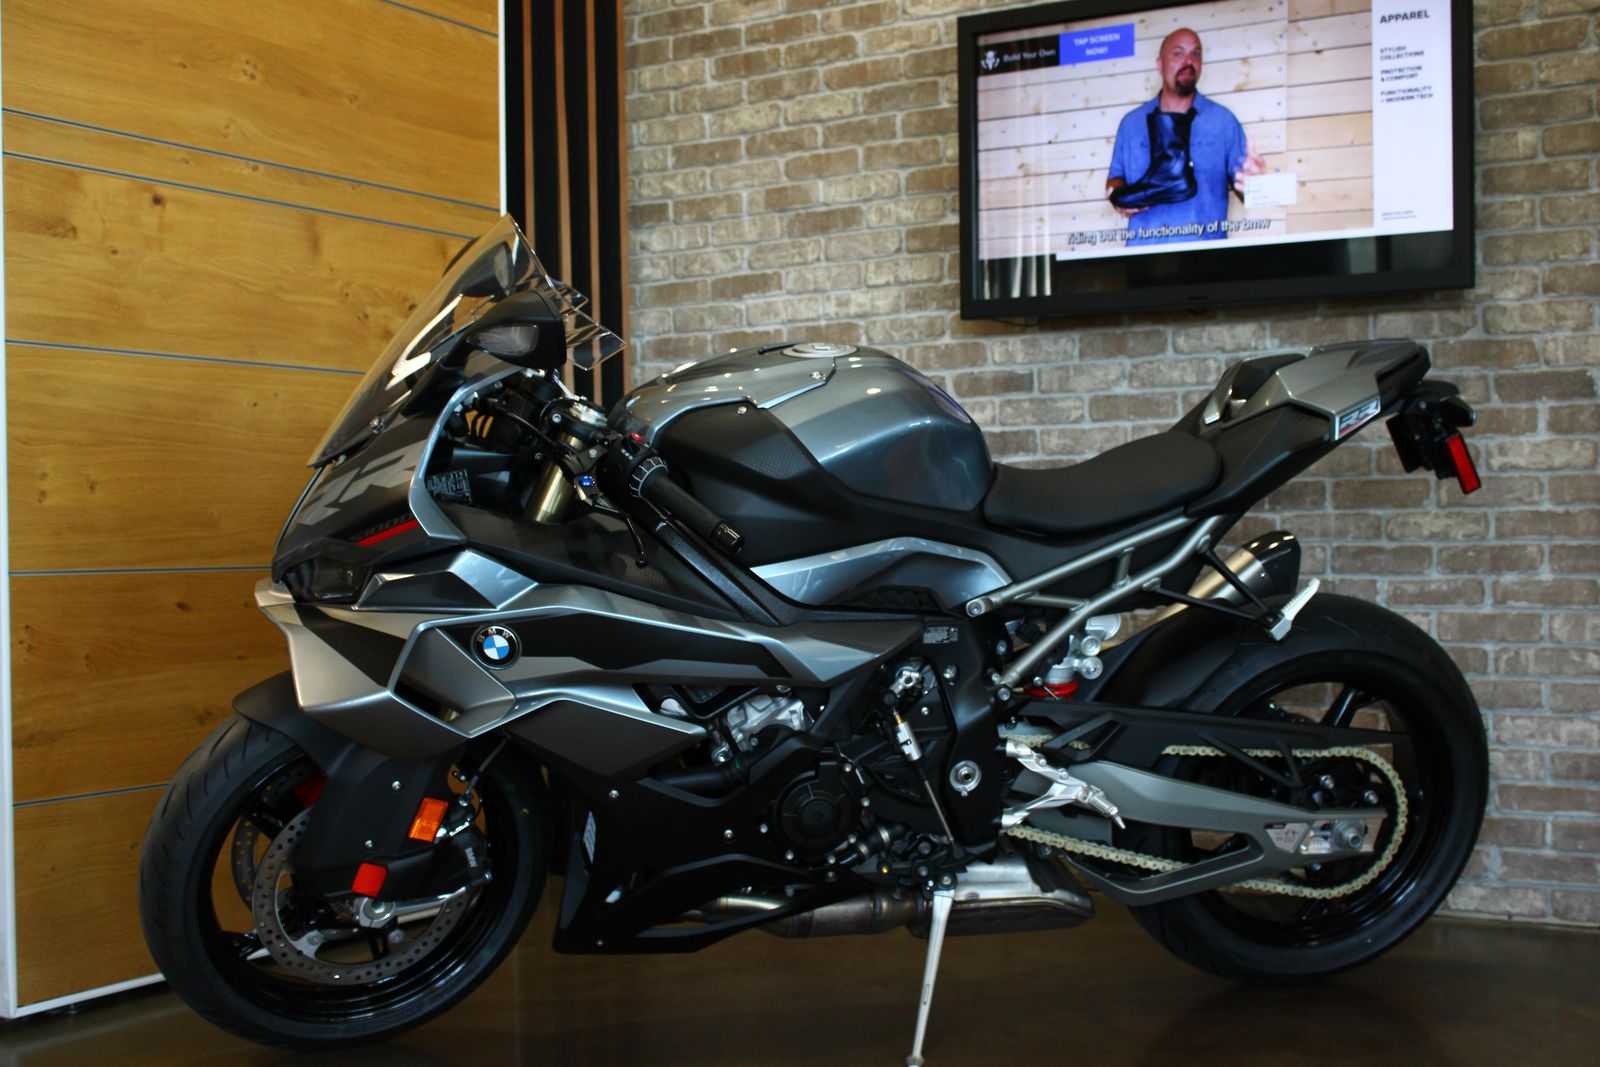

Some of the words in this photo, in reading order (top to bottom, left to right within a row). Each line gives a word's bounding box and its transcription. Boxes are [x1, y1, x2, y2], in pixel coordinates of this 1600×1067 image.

[1380, 10, 1430, 24] APPAREL
[1073, 36, 1088, 46] TAP
[1089, 33, 1121, 44] SCREEN
[1002, 53, 1021, 63] Build
[1023, 51, 1037, 60] Your
[1039, 48, 1056, 58] Own
[1085, 47, 1110, 56] NOW!
[1120, 228, 1136, 241] the
[1138, 222, 1205, 241] functionality
[1207, 220, 1219, 234] of
[1221, 219, 1240, 233] the
[1242, 217, 1272, 231] bmw
[1340, 399, 1378, 429] RR
[477, 628, 511, 643] BMW
